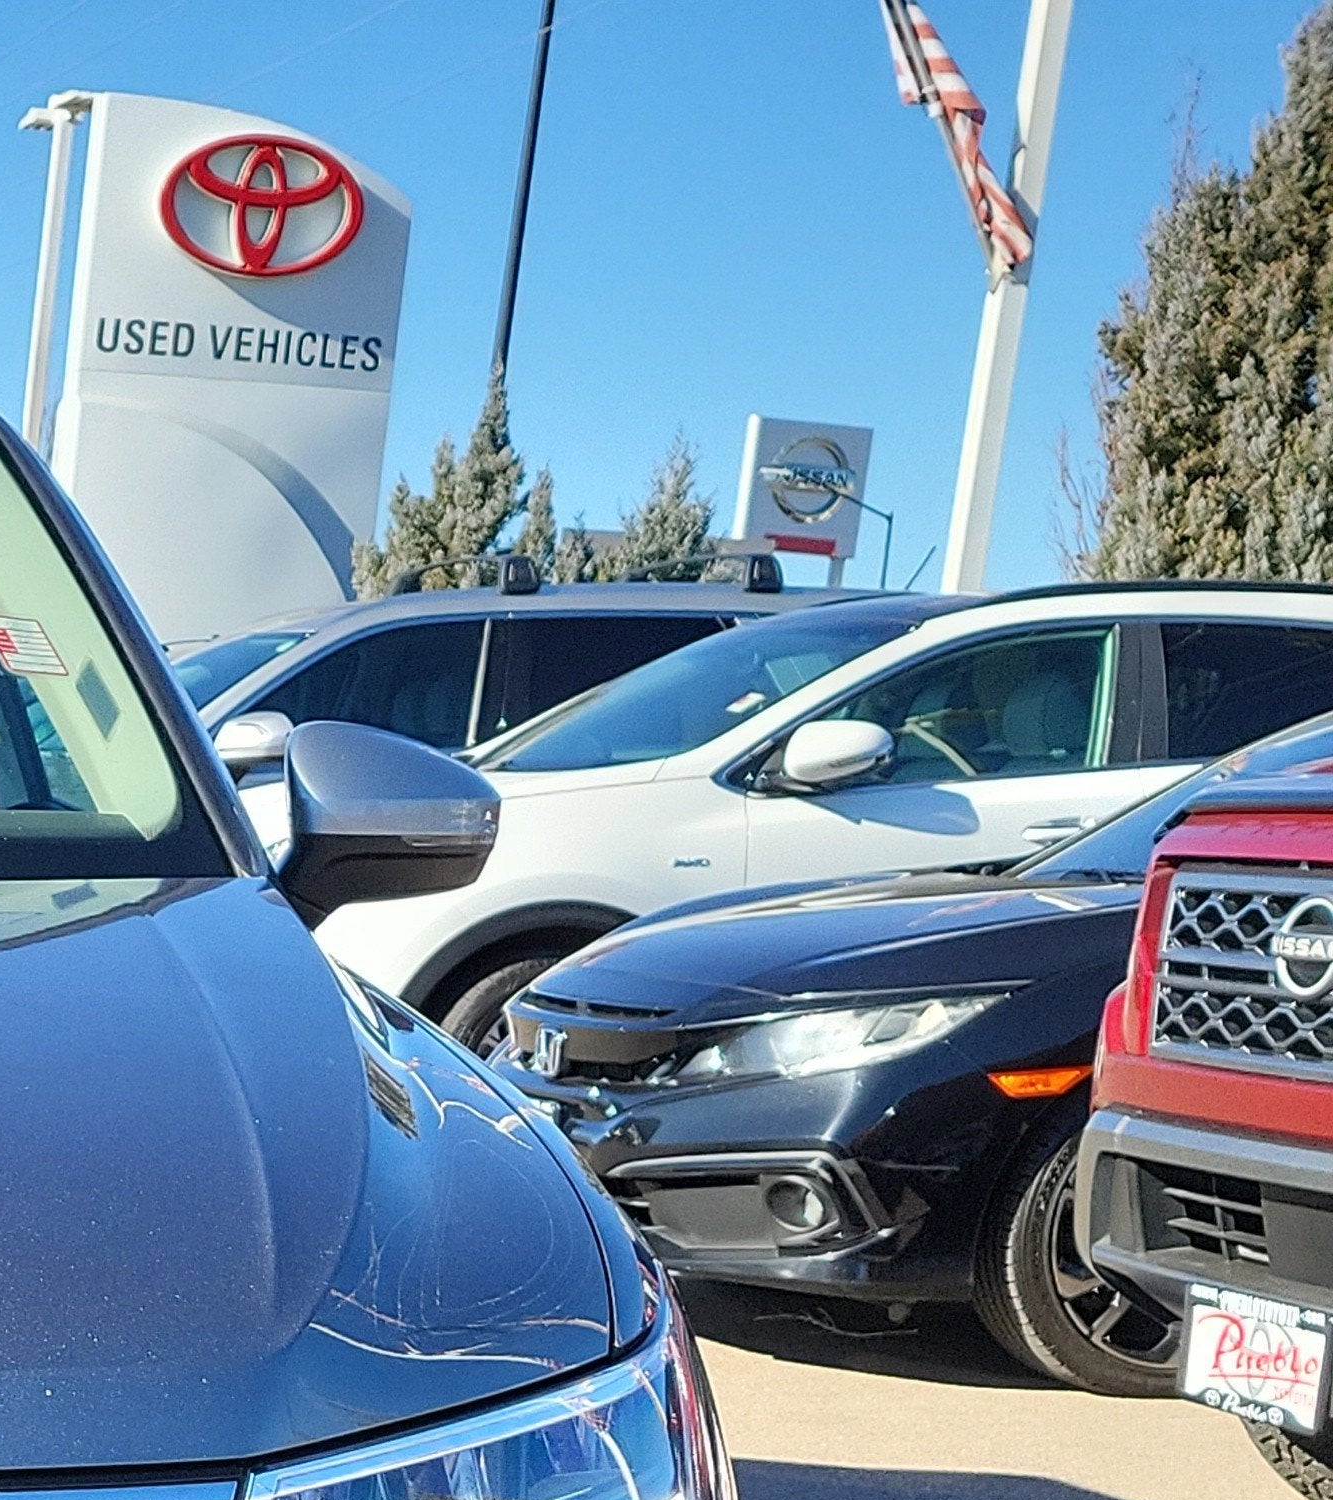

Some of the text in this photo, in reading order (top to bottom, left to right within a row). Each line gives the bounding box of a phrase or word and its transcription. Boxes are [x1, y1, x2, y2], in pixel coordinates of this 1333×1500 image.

[95, 317, 383, 372] USED VEHICLES
[775, 465, 849, 489] NISSAN
[1199, 1313, 1319, 1375] Pueblo
